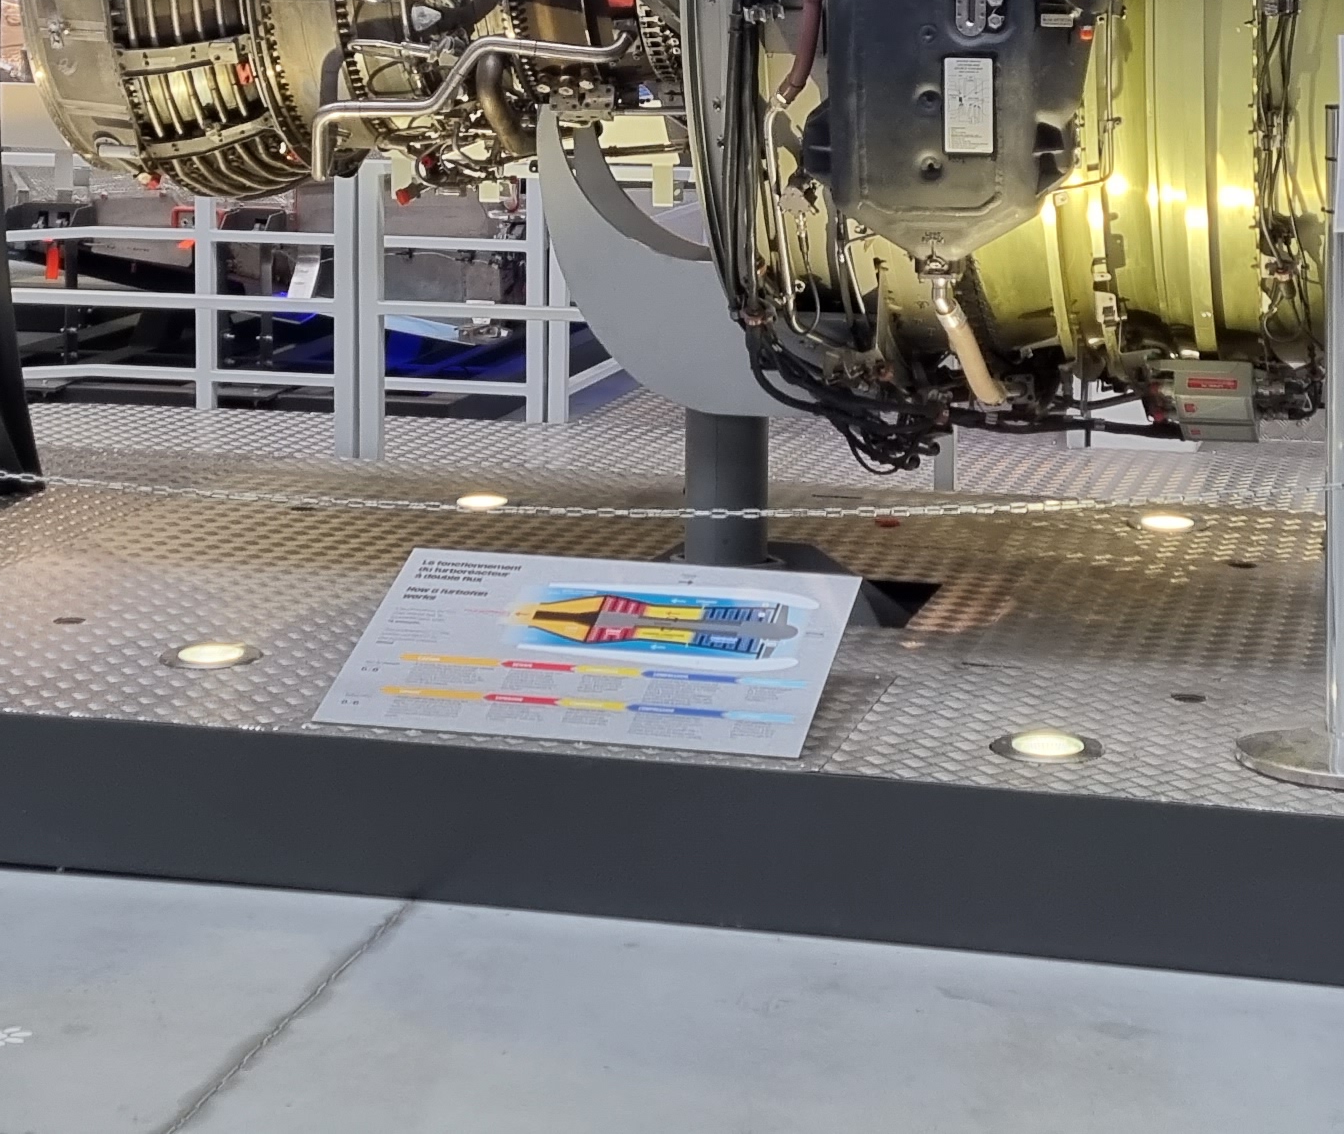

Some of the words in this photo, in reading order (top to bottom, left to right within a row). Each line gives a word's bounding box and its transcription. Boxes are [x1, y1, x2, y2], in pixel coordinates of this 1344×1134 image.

[437, 560, 523, 572] fonctionnement
[434, 567, 511, 578] turboréacteur
[423, 573, 461, 582] double
[461, 575, 483, 583] flux
[402, 593, 437, 601] works
[439, 588, 489, 598] turbofan
